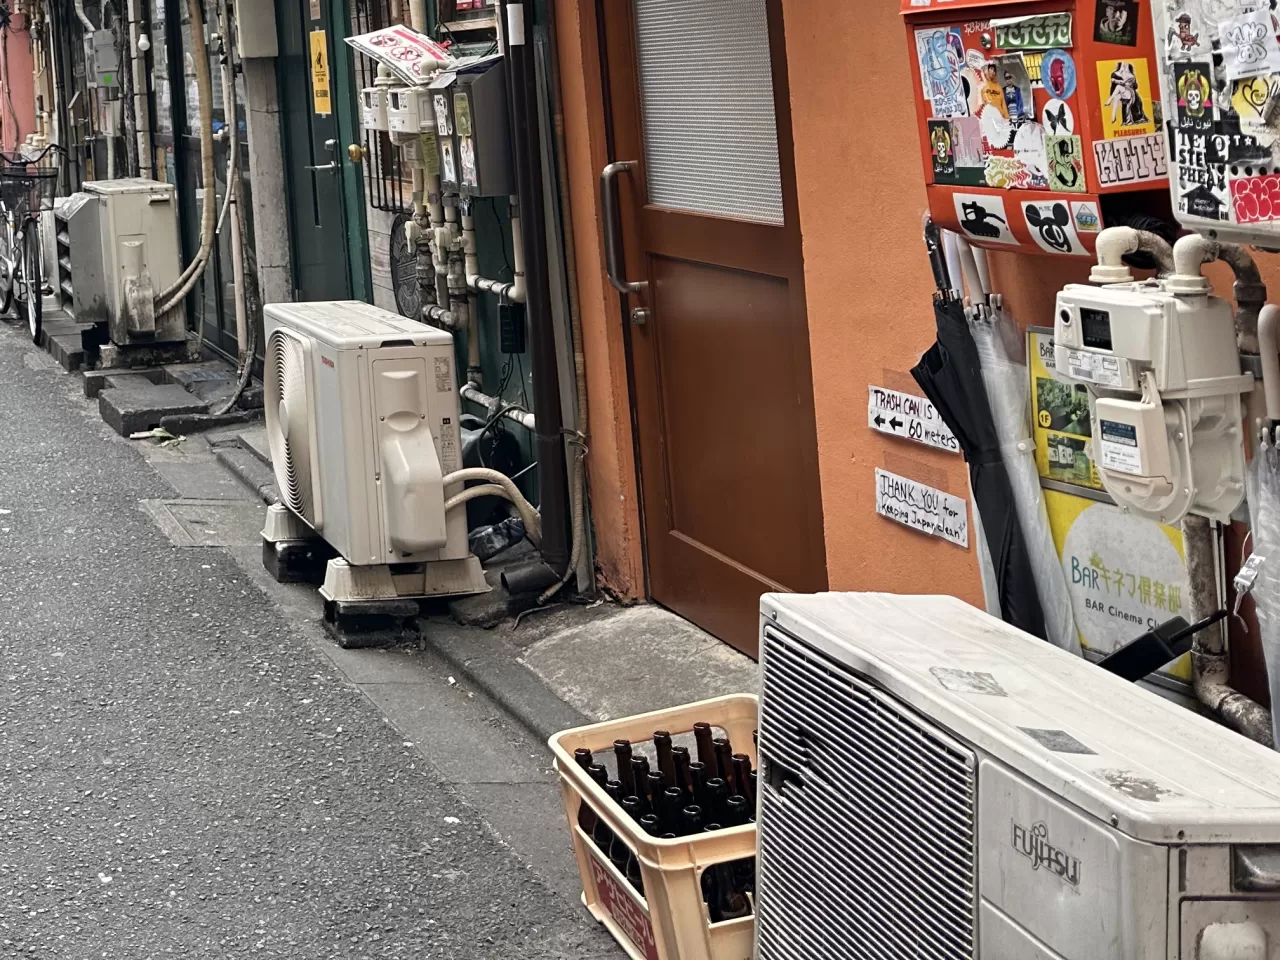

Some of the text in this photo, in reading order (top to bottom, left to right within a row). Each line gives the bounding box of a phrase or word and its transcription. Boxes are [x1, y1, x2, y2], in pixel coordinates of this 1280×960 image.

[1113, 128, 1147, 138] PLEASURES
[874, 389, 902, 411] TRASH
[904, 397, 920, 416] CAN
[924, 404, 933, 420] IS
[1040, 413, 1050, 423] 1F
[909, 418, 957, 449] 60 meters
[881, 474, 959, 519] THANK YOU for
[881, 498, 910, 524] keeping
[911, 512, 936, 532] Japan
[1086, 598, 1105, 613] BAR
[1109, 605, 1143, 626] Cinema
[1013, 823, 1079, 886] FUJITSU
